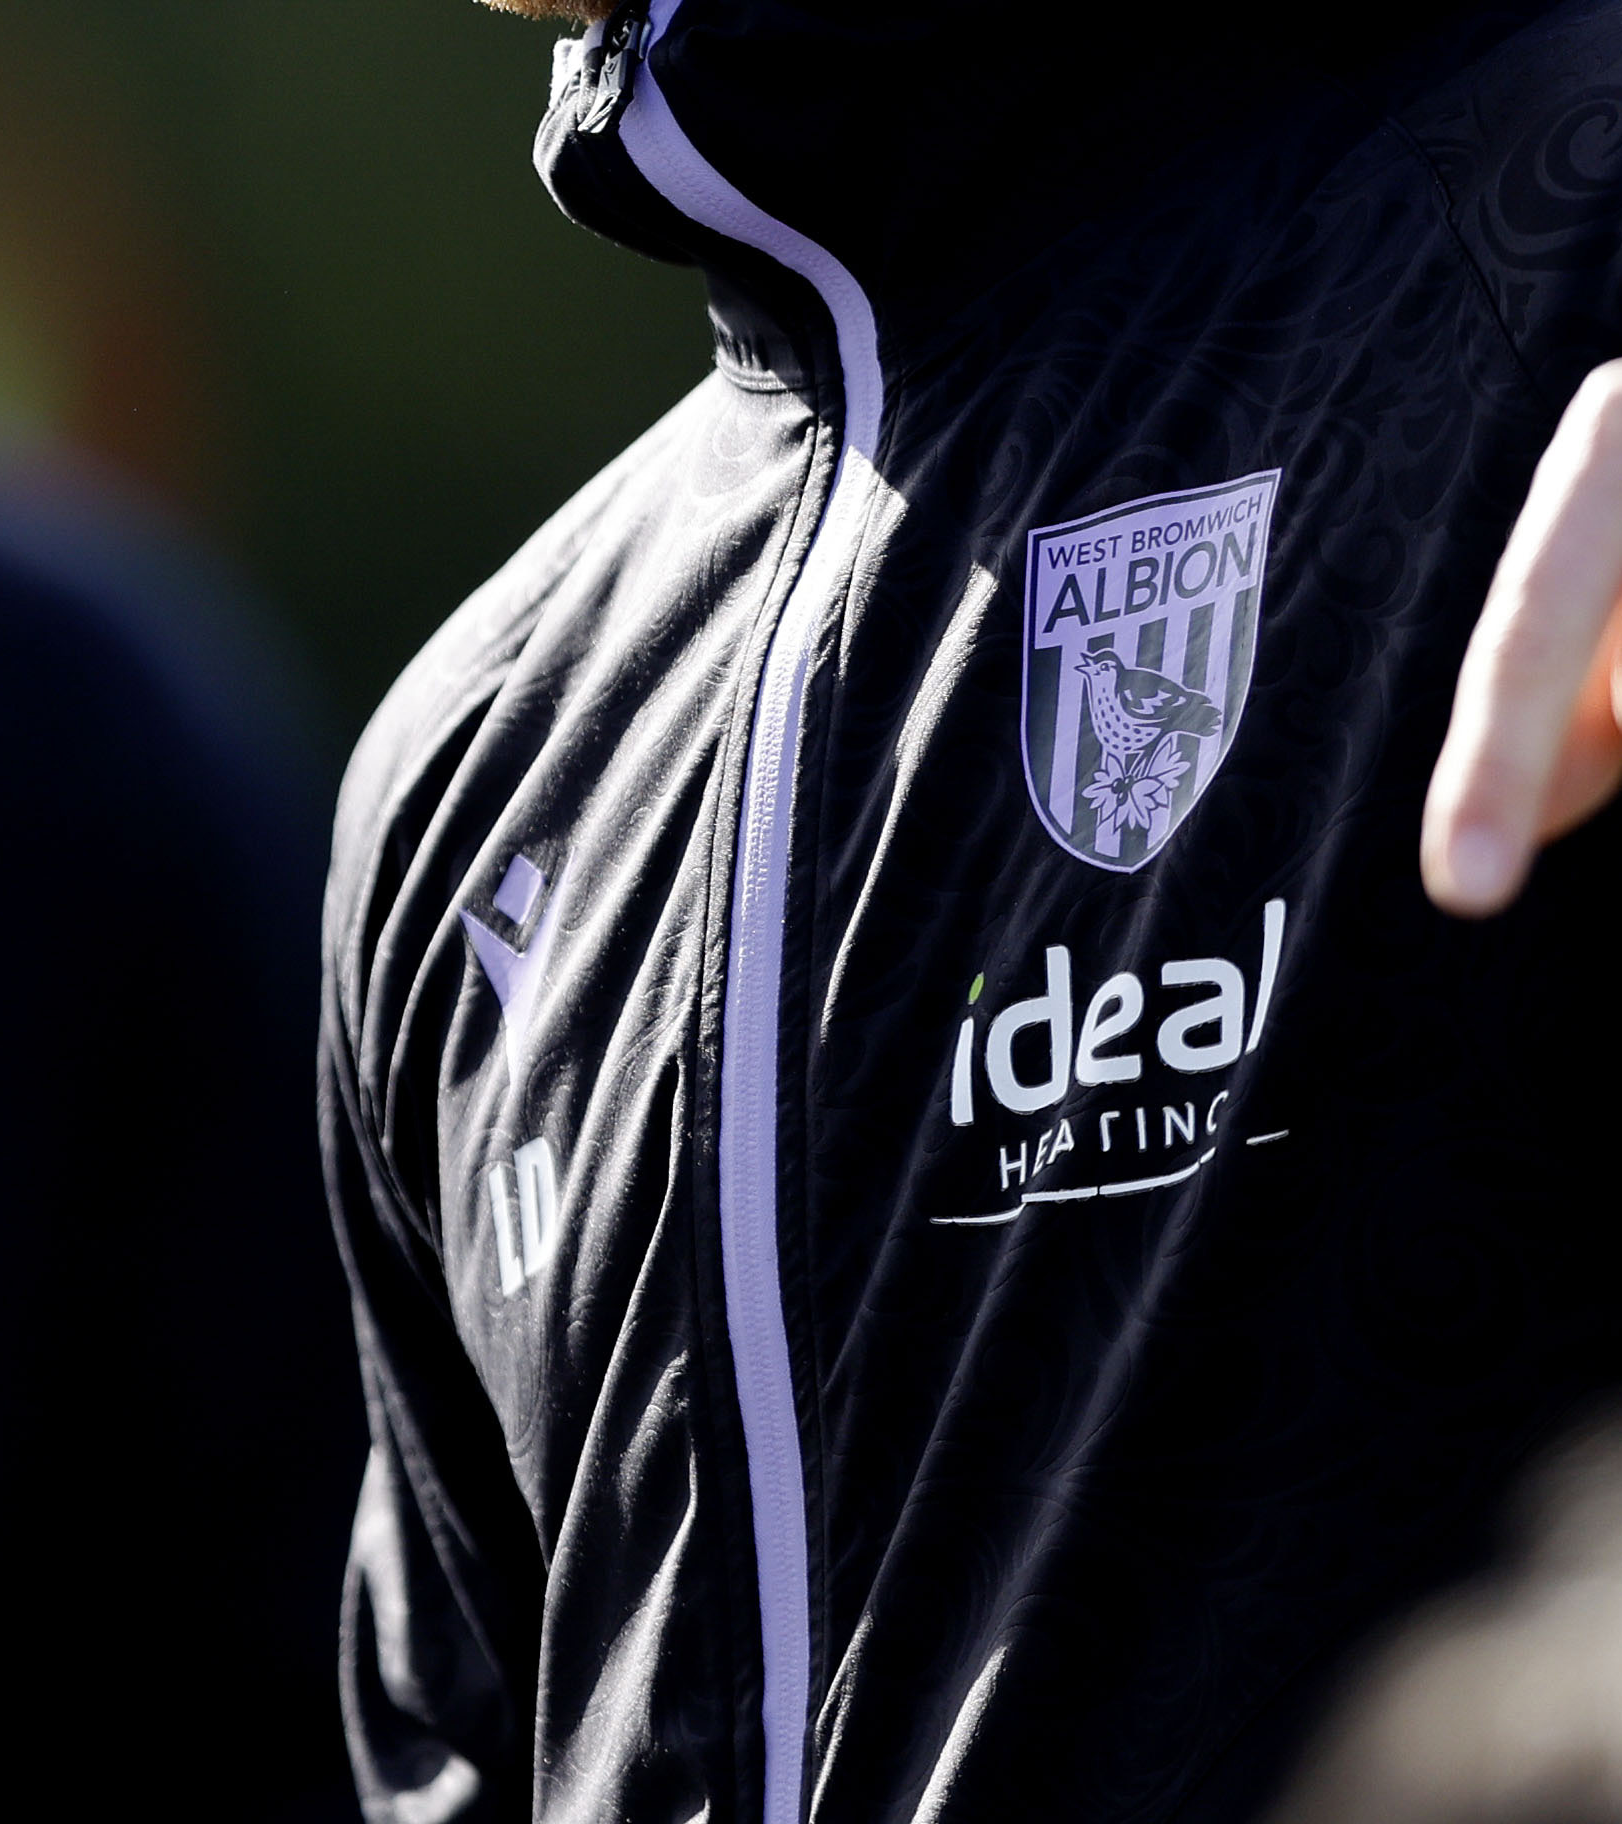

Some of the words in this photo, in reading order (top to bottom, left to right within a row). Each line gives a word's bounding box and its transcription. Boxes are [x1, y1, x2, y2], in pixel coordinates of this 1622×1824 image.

[1043, 522, 1257, 634] ALBION
[1048, 536, 1123, 569] WEST
[1131, 493, 1262, 553] BROMWICH
[952, 899, 1285, 1125] ideal
